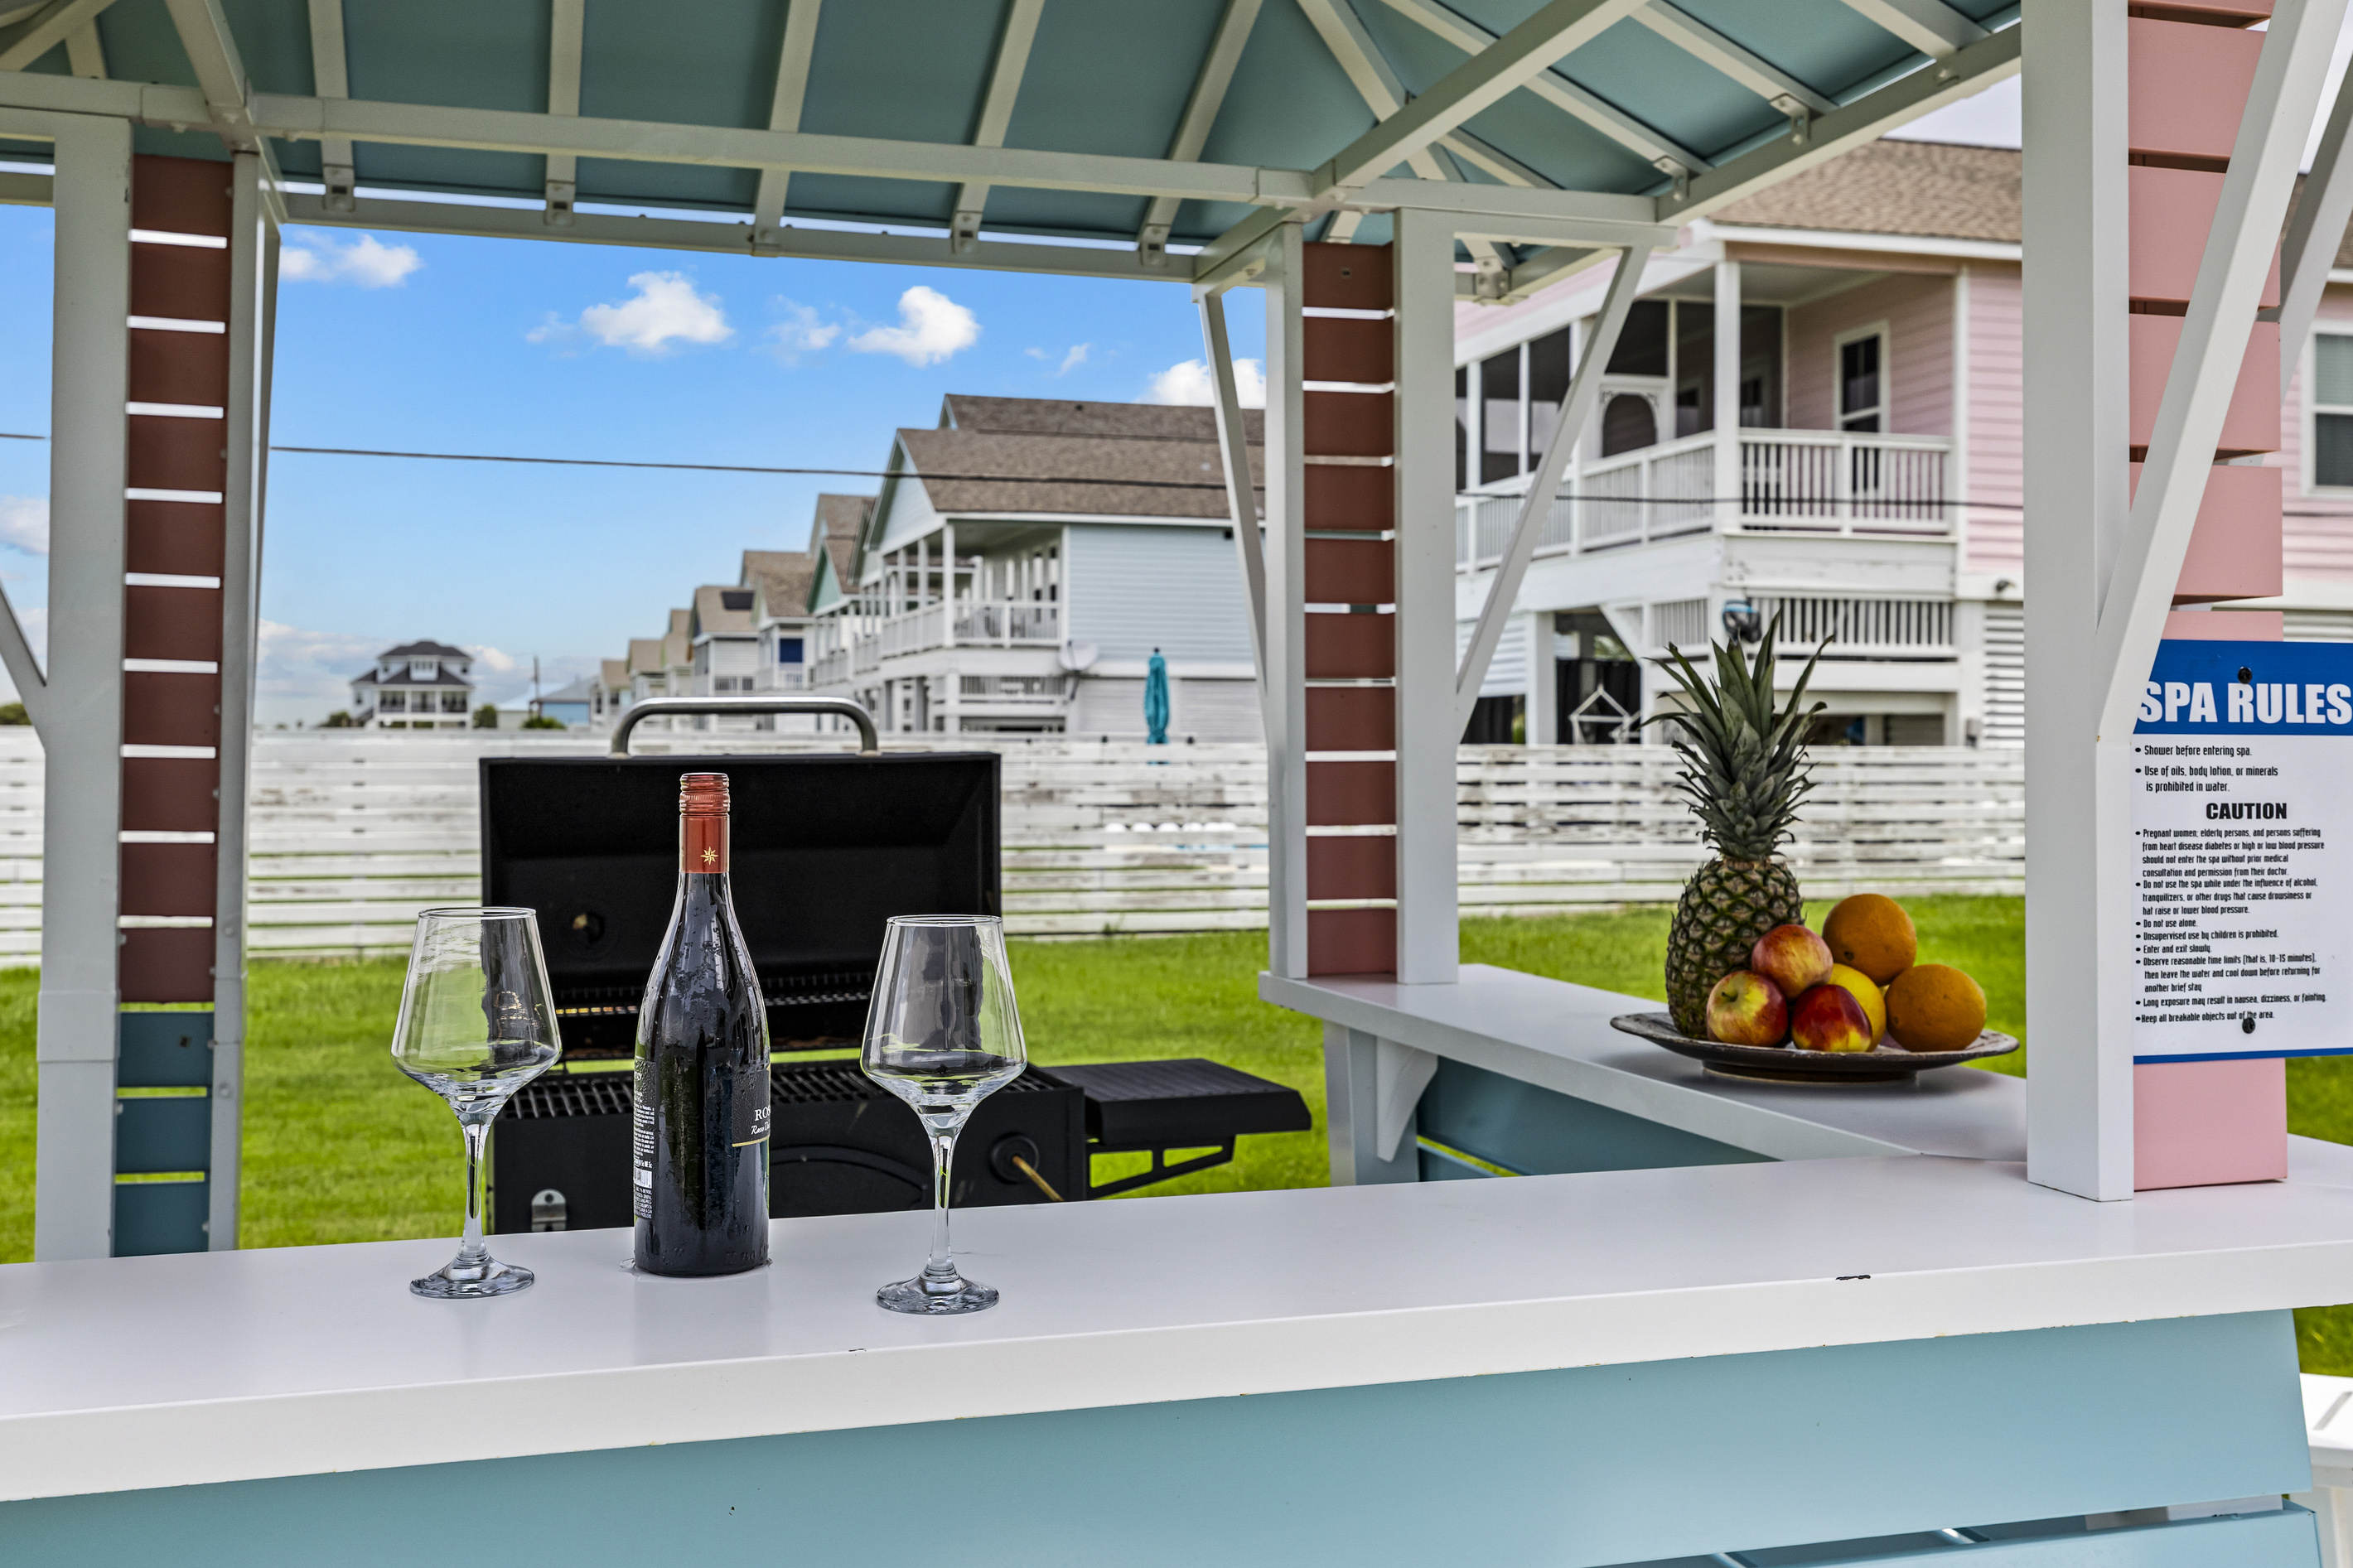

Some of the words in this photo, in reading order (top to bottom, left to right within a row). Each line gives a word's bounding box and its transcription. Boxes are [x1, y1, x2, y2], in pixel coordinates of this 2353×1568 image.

[2138, 681, 2218, 723] SPA
[2228, 683, 2352, 725] RULES
[2144, 745, 2174, 755] Shower
[2176, 745, 2201, 757] before
[2202, 745, 2235, 758] entering
[2236, 747, 2253, 757] spa.
[2144, 765, 2159, 776] Use
[2161, 765, 2169, 778] of
[2189, 765, 2208, 778] body
[2235, 767, 2244, 776] or
[2245, 766, 2278, 776] minerals
[2146, 781, 2153, 792] is
[2155, 781, 2194, 794] prohibited
[2196, 782, 2204, 792] in
[2206, 782, 2230, 792] water.
[2206, 803, 2287, 820] CAUTION
[2143, 828, 2172, 839] Pregnant
[2201, 828, 2222, 838] elderly
[2253, 828, 2264, 837] and
[2266, 829, 2292, 838] persons
[2292, 827, 2322, 838] suffering
[2143, 842, 2157, 852] from
[2159, 842, 2177, 851] heart
[2178, 842, 2203, 851] disease
[2205, 842, 2232, 850] diabetes
[2242, 842, 2255, 852] high
[2265, 842, 2277, 850] low
[2278, 842, 2296, 850] blood
[2297, 842, 2325, 851] pressure
[2142, 855, 2164, 864] should
[2166, 855, 2177, 864] not
[2177, 855, 2194, 864] enter
[2196, 855, 2206, 863] the
[2208, 856, 2220, 865] spa
[2221, 855, 2245, 863] without
[2247, 855, 2262, 864] prior
[2264, 854, 2288, 862] medical
[2143, 868, 2182, 877] consultation
[2184, 868, 2196, 876] and
[2197, 868, 2232, 878] permission
[2234, 868, 2249, 877] from
[2143, 880, 2152, 889] Do
[2152, 880, 2164, 888] not
[2178, 880, 2189, 888] the
[2191, 880, 2202, 890] spa
[2204, 880, 2221, 888] while
[2223, 879, 2240, 887] under
[2243, 879, 2253, 887] the
[2254, 878, 2283, 888] influence
[2285, 878, 2292, 888] of
[2196, 893, 2212, 901] other
[2214, 892, 2232, 902] drugs
[2233, 892, 2246, 900] that
[2268, 891, 2304, 900] drowsiness
[2143, 906, 2153, 915] hat
[2155, 906, 2171, 915] raise
[2181, 906, 2200, 914] lower
[2201, 905, 2219, 914] blood
[2143, 919, 2152, 928] Do
[2152, 919, 2164, 928] not
[2143, 931, 2186, 942] Unsupervised
[2201, 931, 2210, 941] by
[2210, 930, 2237, 939] children
[2238, 930, 2244, 938] is
[2143, 945, 2160, 954] Enter
[2162, 944, 2174, 953] and
[2176, 944, 2187, 953] exit
[2143, 958, 2169, 966] Observe
[2171, 956, 2206, 965] reasonable
[2207, 956, 2222, 964] time
[2223, 955, 2241, 964] limits
[2269, 954, 2286, 963] 10-15
[2144, 971, 2159, 979] then
[2161, 971, 2178, 979] leave
[2180, 970, 2190, 978] the
[2191, 969, 2210, 978] water
[2212, 969, 2224, 977] and
[2225, 968, 2239, 977] cool
[2240, 968, 2259, 977] down
[2259, 967, 2280, 977] before
[2282, 967, 2310, 977] returning
[2312, 966, 2321, 976] for
[2144, 984, 2169, 993] another
[2171, 982, 2186, 993] brief
[2187, 982, 2202, 992] stay
[2143, 998, 2159, 1008] Long
[2161, 998, 2191, 1007] exposure
[2191, 998, 2206, 1006] may
[2207, 996, 2225, 1005] result
[2226, 996, 2233, 1004] in
[2141, 1014, 2157, 1024] Keep
[2158, 1014, 2167, 1022] all
[2168, 1012, 2201, 1022] breakable
[2201, 1012, 2225, 1022] objects
[2226, 1011, 2237, 1020] out
[2239, 1011, 2246, 1020] of
[2247, 1011, 2257, 1020] the
